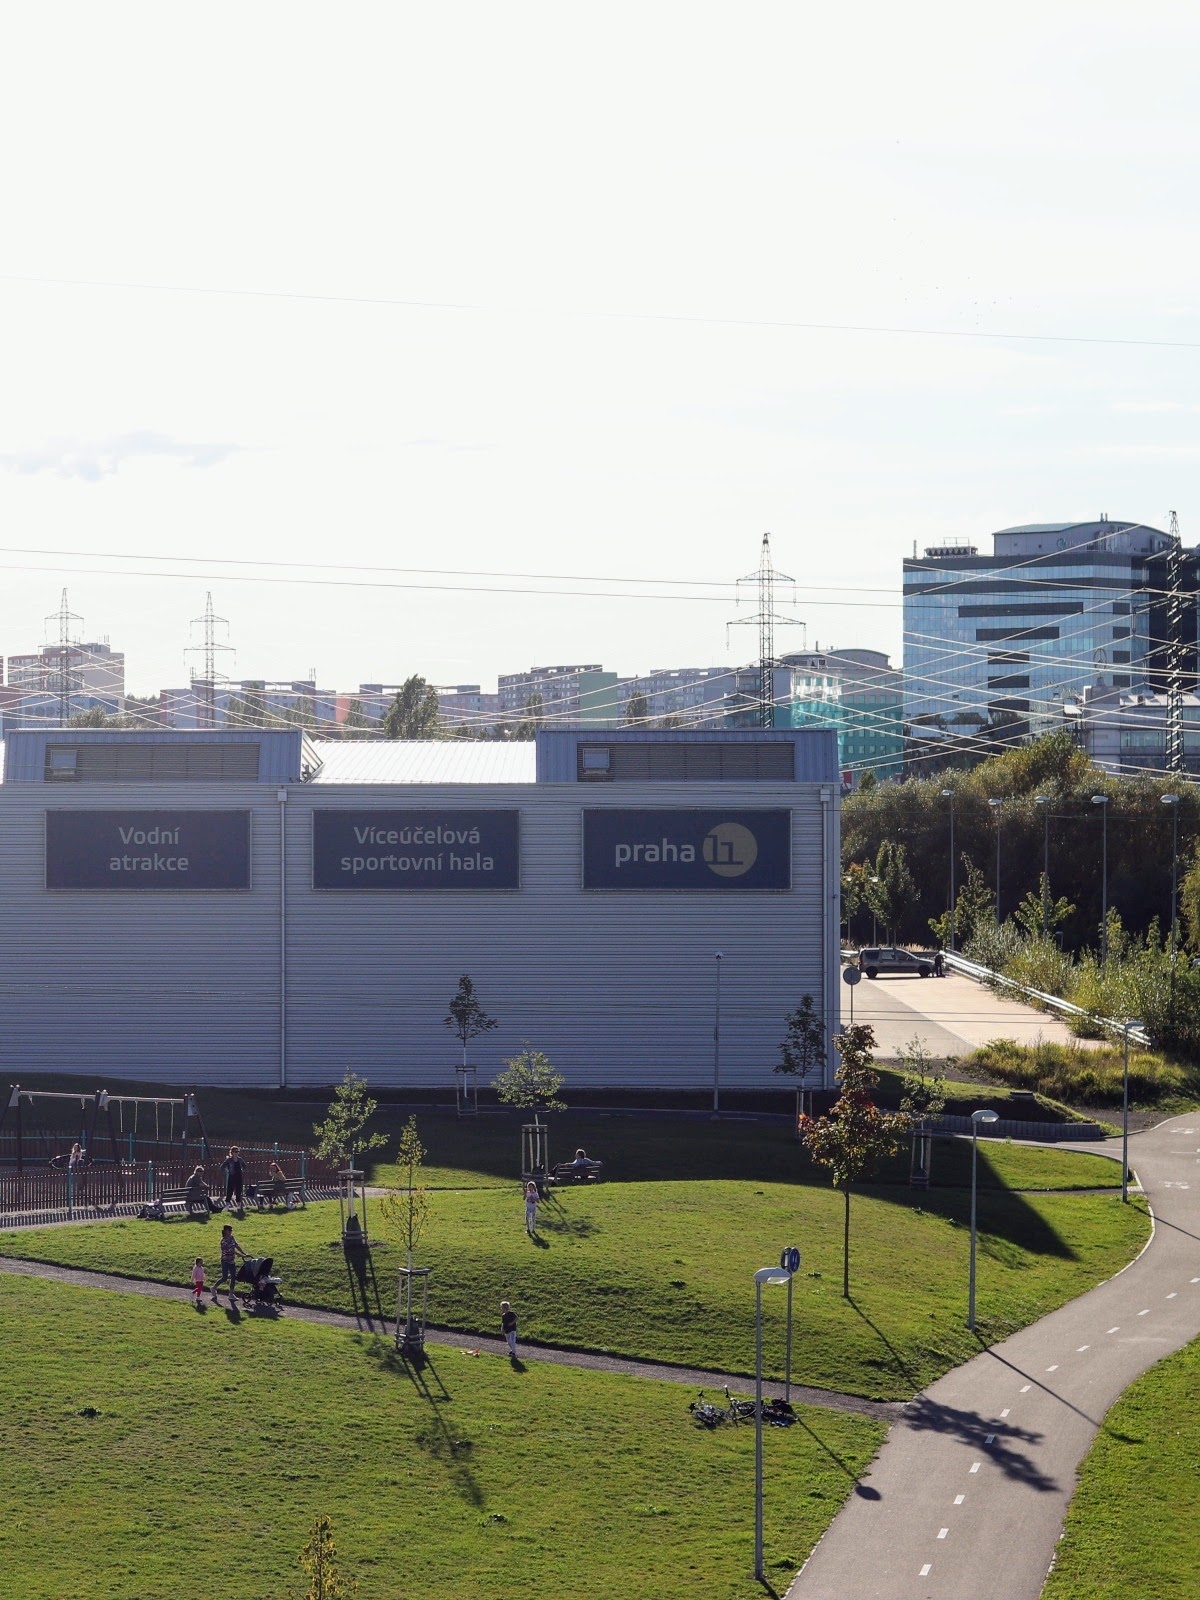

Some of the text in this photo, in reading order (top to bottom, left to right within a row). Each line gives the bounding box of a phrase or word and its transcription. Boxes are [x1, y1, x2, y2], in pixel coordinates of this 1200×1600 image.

[118, 826, 181, 845] Vodní
[353, 826, 480, 845] Víceúčelová
[109, 852, 189, 871] atrakce
[615, 838, 695, 868] praha
[341, 852, 494, 875] sportovní hala
